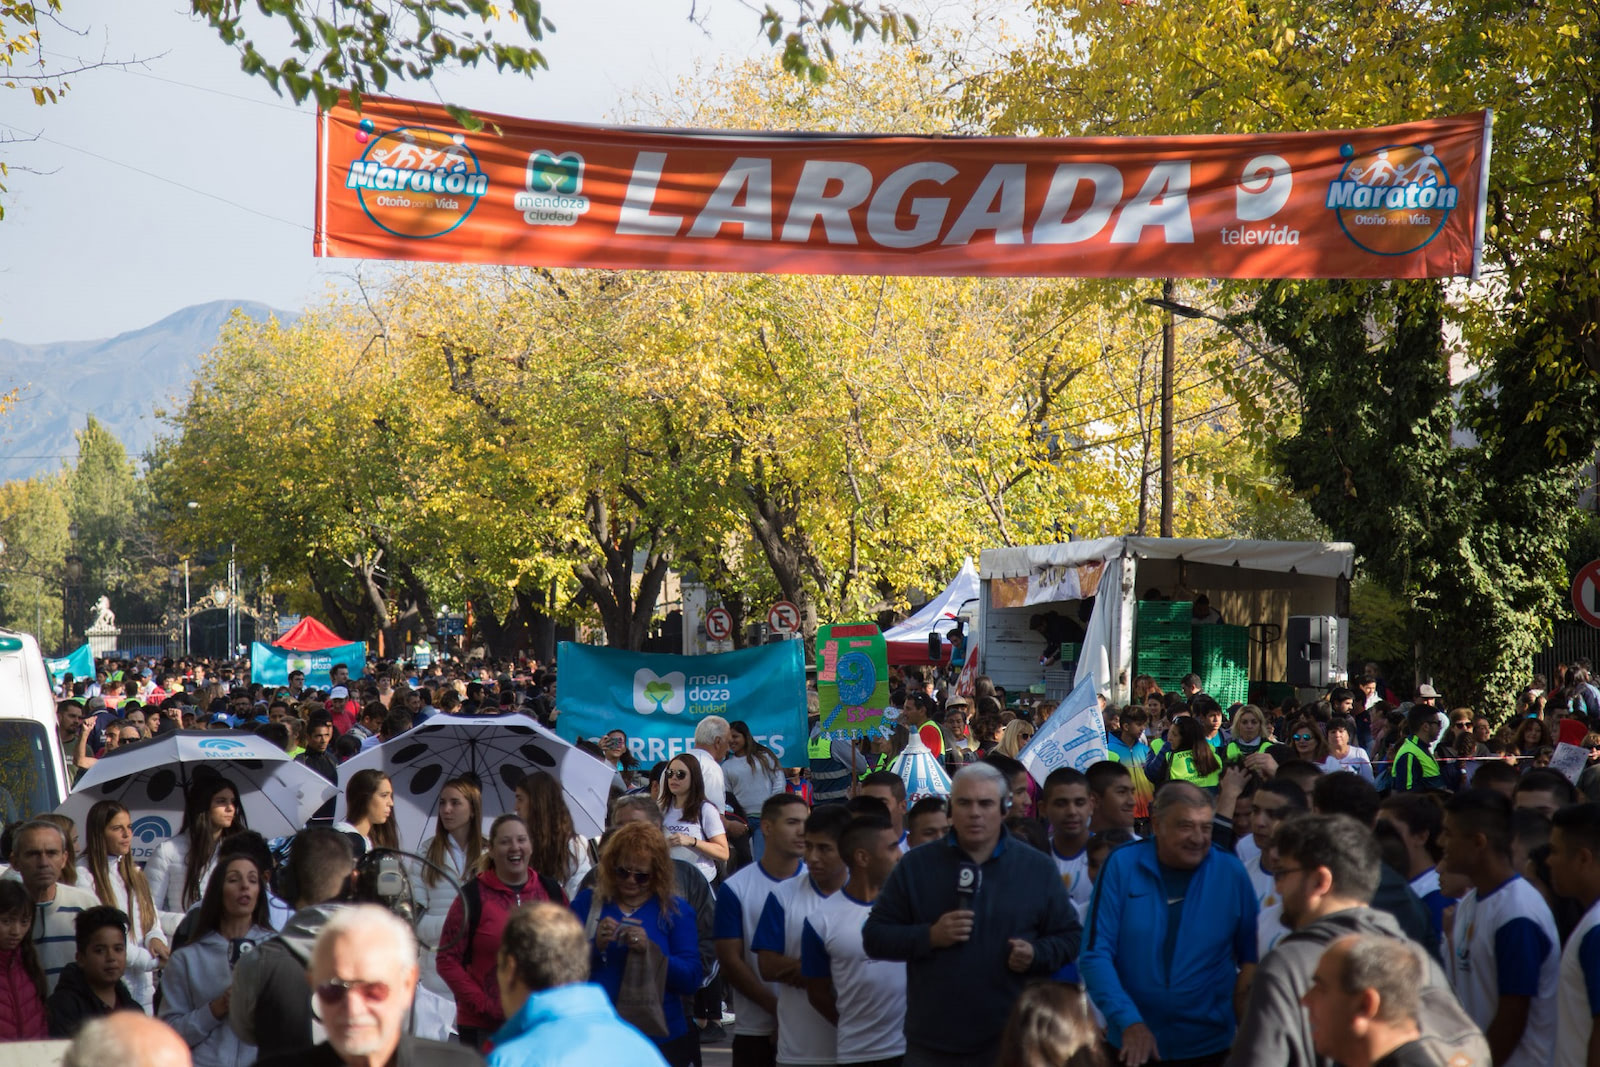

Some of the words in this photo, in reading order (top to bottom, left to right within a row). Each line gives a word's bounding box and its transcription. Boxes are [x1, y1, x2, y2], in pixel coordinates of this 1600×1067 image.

[348, 161, 488, 196] Maratón
[1326, 176, 1458, 209] Maratón
[377, 195, 410, 208] Otoño
[435, 197, 459, 210] Vida
[518, 195, 585, 209] mendoza
[615, 151, 1195, 249] LARGADA
[528, 210, 574, 222] ciudad
[1355, 214, 1387, 225] Otoño
[1409, 213, 1431, 225] Vida
[1220, 225, 1300, 245] televida
[688, 673, 729, 686] men
[688, 688, 731, 701] doza
[688, 702, 727, 715] ciudad
[847, 706, 866, 723] 53
